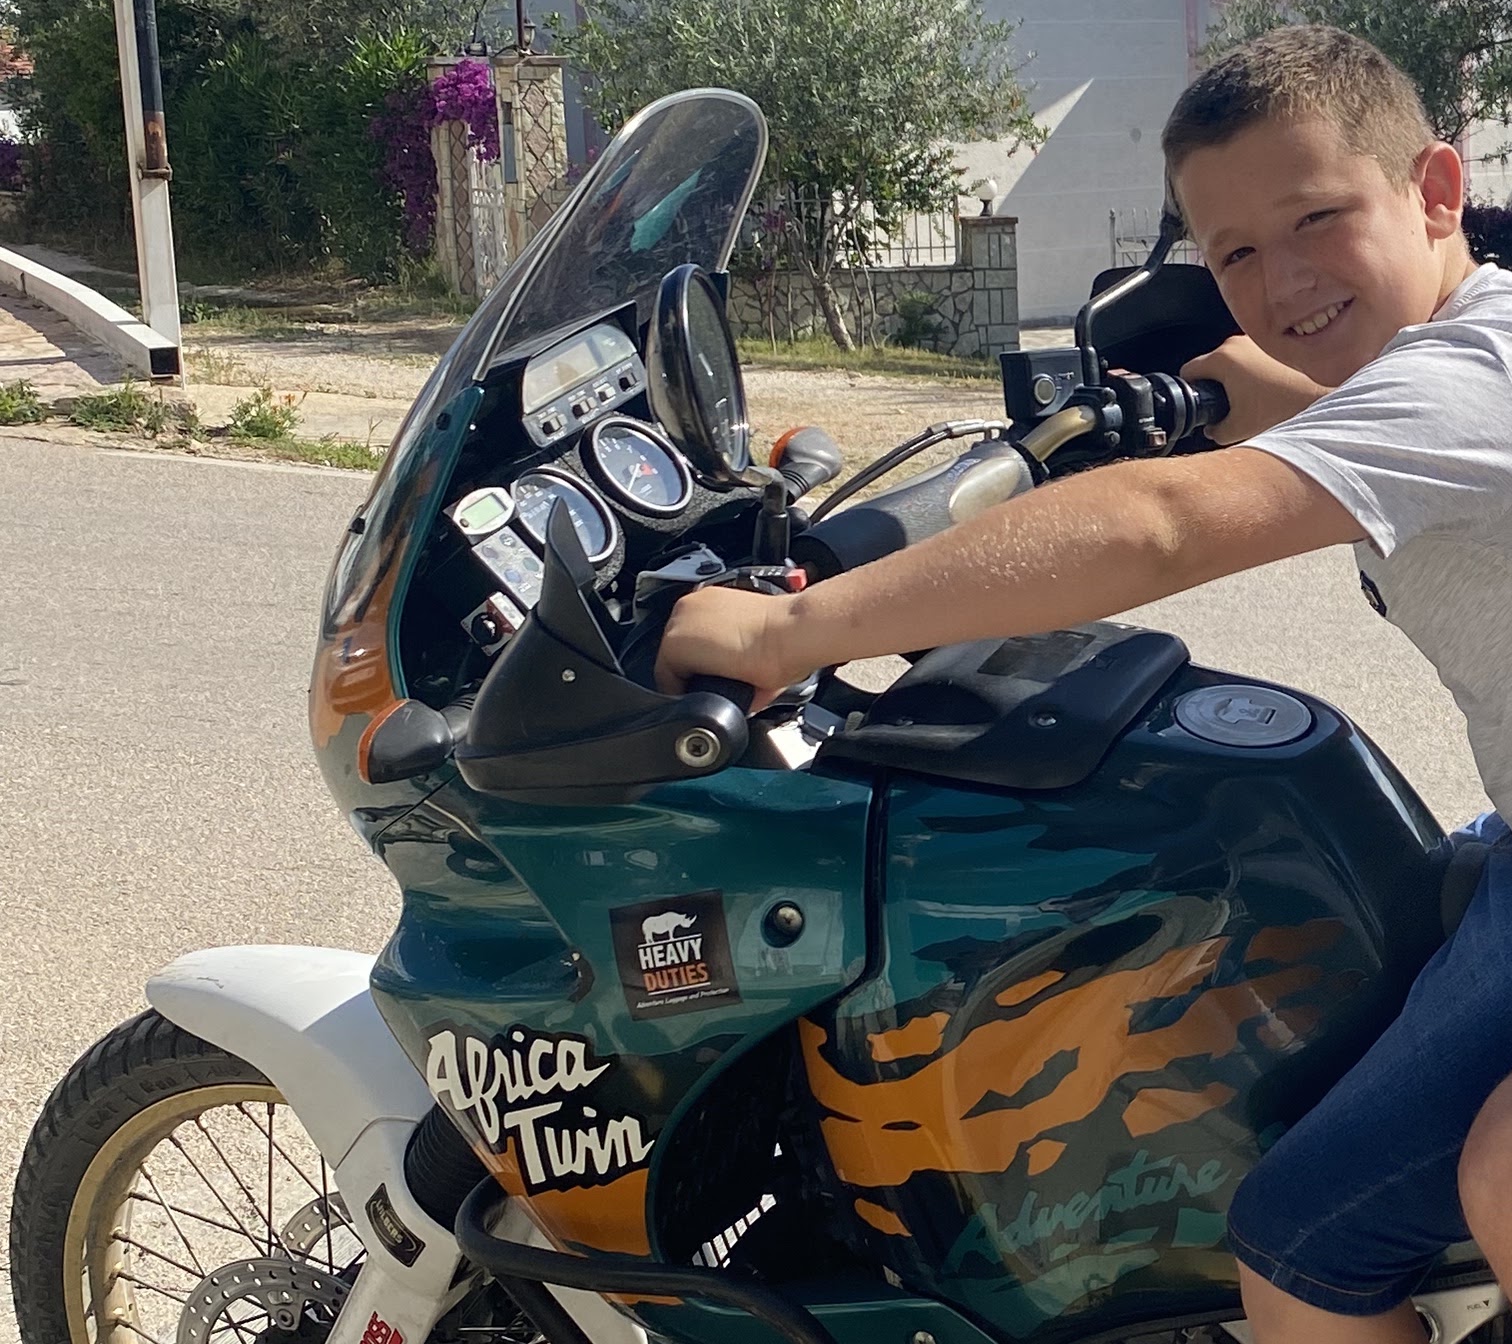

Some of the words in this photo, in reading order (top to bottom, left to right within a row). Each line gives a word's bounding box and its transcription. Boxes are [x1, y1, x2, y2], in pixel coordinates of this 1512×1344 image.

[638, 937, 702, 970] HEAVY
[642, 962, 709, 992] DUTIES
[426, 1030, 610, 1144] Africa
[504, 1102, 655, 1185] Twin
